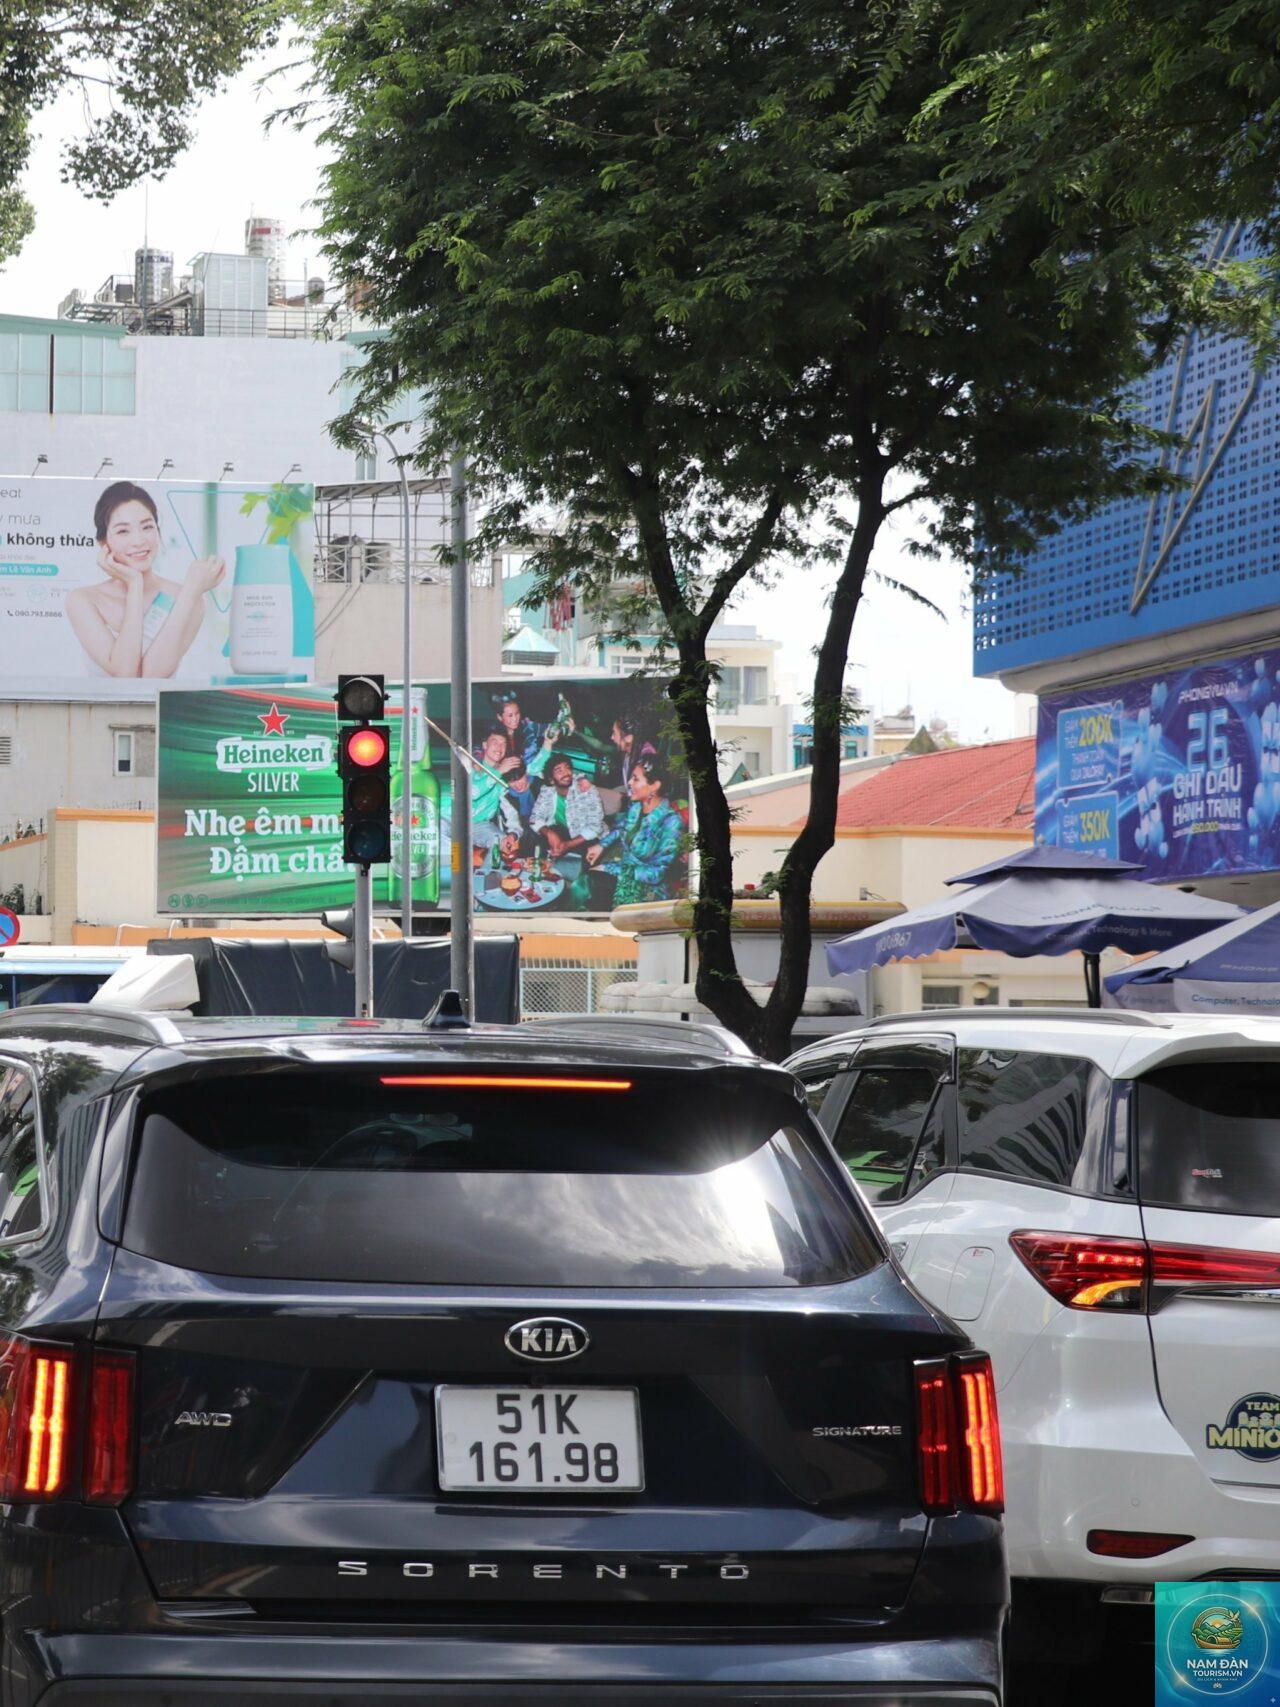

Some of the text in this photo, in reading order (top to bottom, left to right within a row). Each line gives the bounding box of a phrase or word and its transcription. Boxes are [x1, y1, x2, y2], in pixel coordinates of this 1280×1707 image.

[8, 513, 42, 525] mưa
[6, 532, 56, 549] không
[60, 533, 95, 548] thừa
[223, 744, 325, 764] Heineken
[247, 771, 300, 793] SILVER
[1173, 771, 1201, 800] GHI
[1172, 799, 1204, 827] HÀNH
[184, 809, 246, 845] Nhẹ
[254, 806, 303, 836] êm
[209, 845, 281, 882] Đậm
[520, 1327, 577, 1352] KIA
[496, 1393, 580, 1435] 51K
[1246, 1401, 1280, 1411] TEAM
[174, 1411, 232, 1427] AWD
[812, 1425, 902, 1437] SIGNATURE
[469, 1441, 619, 1484] 161.98
[337, 1560, 750, 1581] SORENTO
